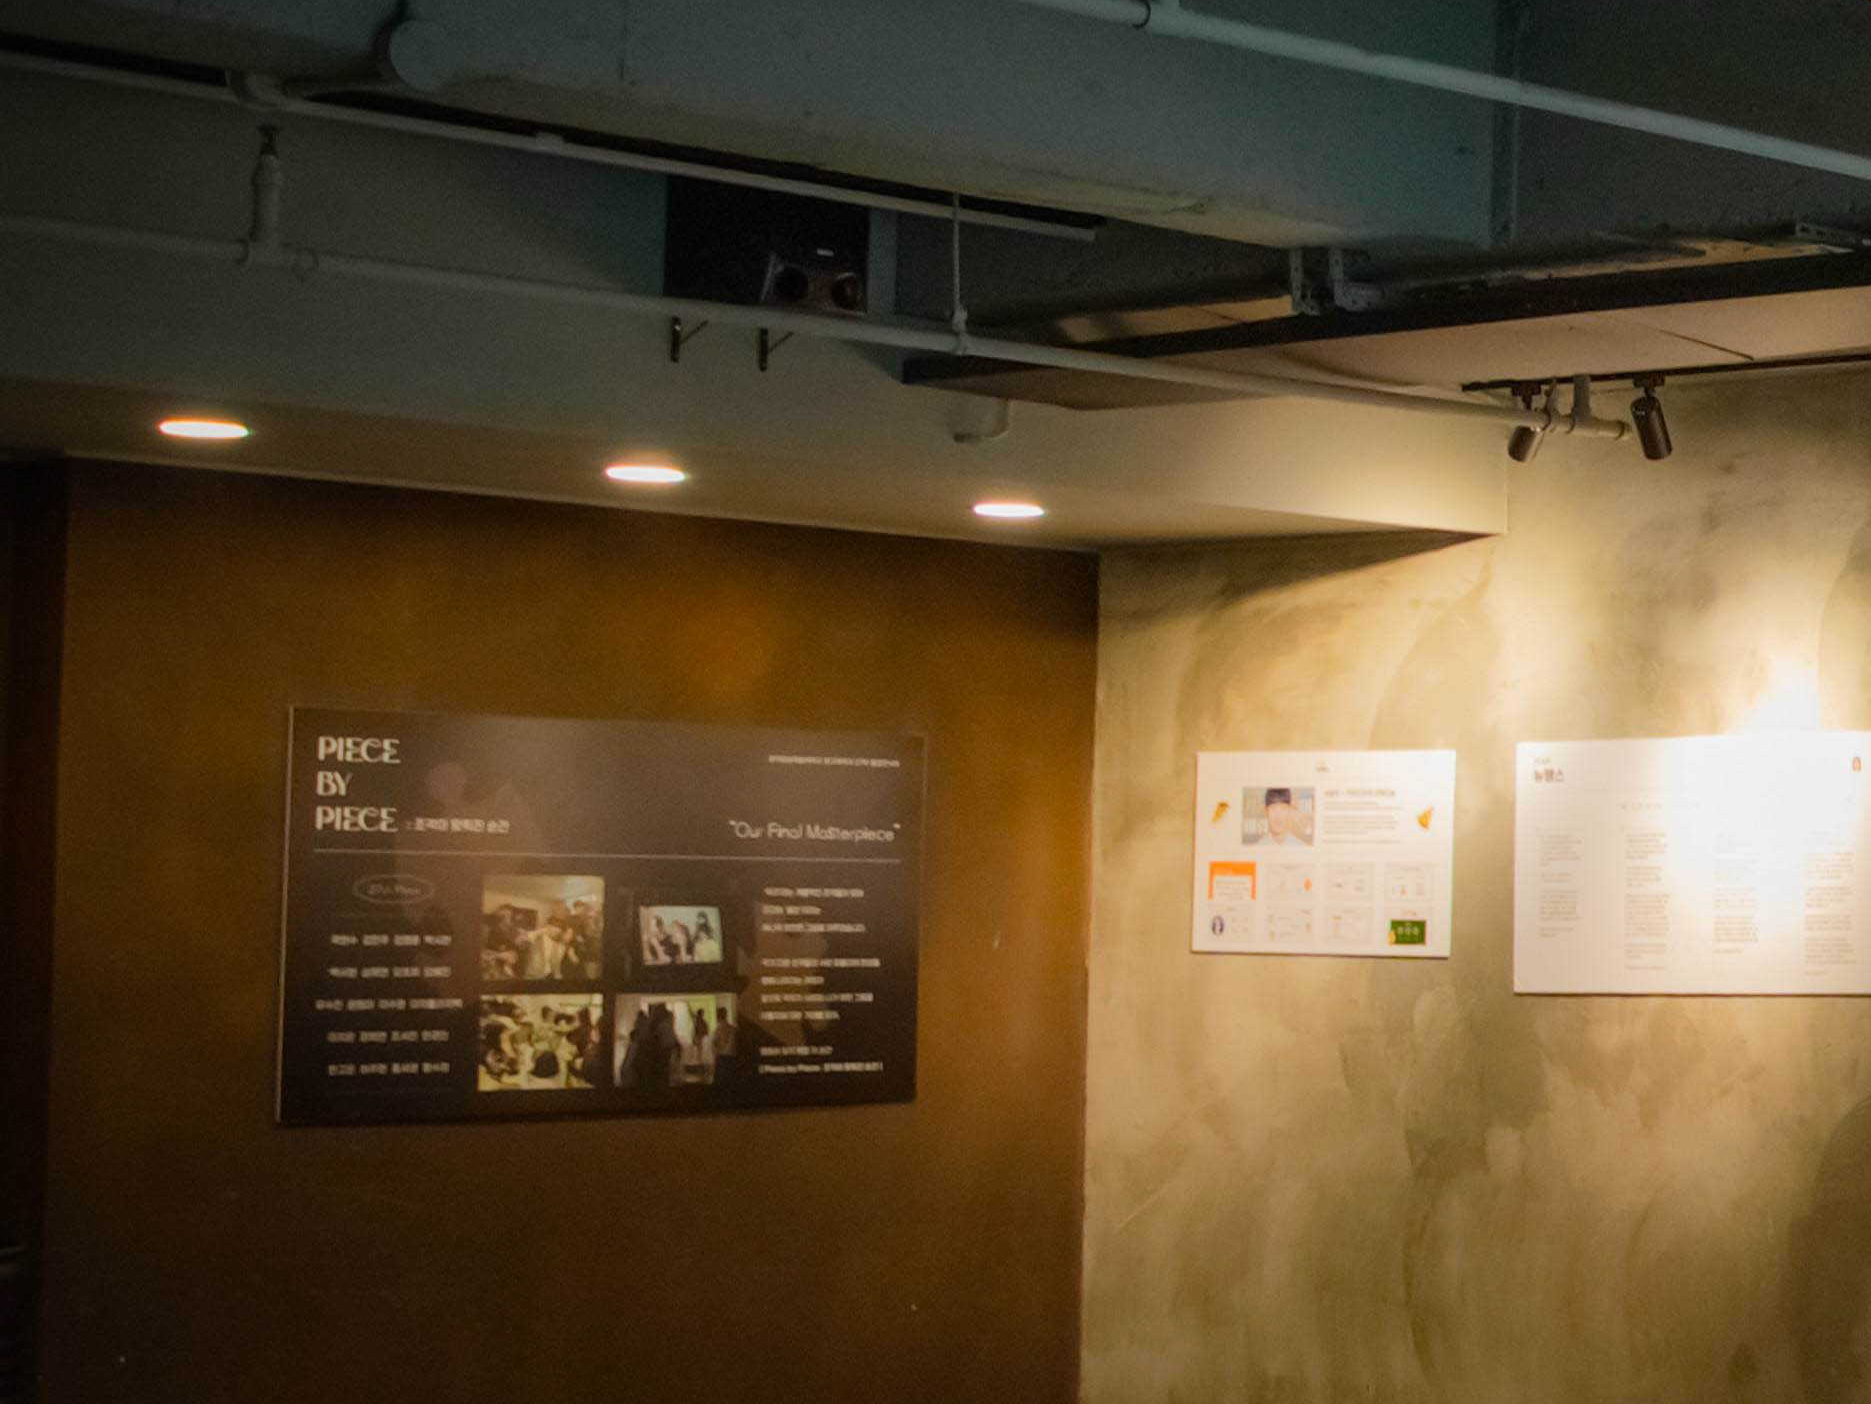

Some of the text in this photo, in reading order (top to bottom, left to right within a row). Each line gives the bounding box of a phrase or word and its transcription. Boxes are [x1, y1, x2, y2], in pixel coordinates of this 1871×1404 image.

[317, 736, 401, 764] PIECE
[316, 770, 352, 796] BY
[315, 805, 399, 833] PIECE
[767, 821, 803, 840] Final
